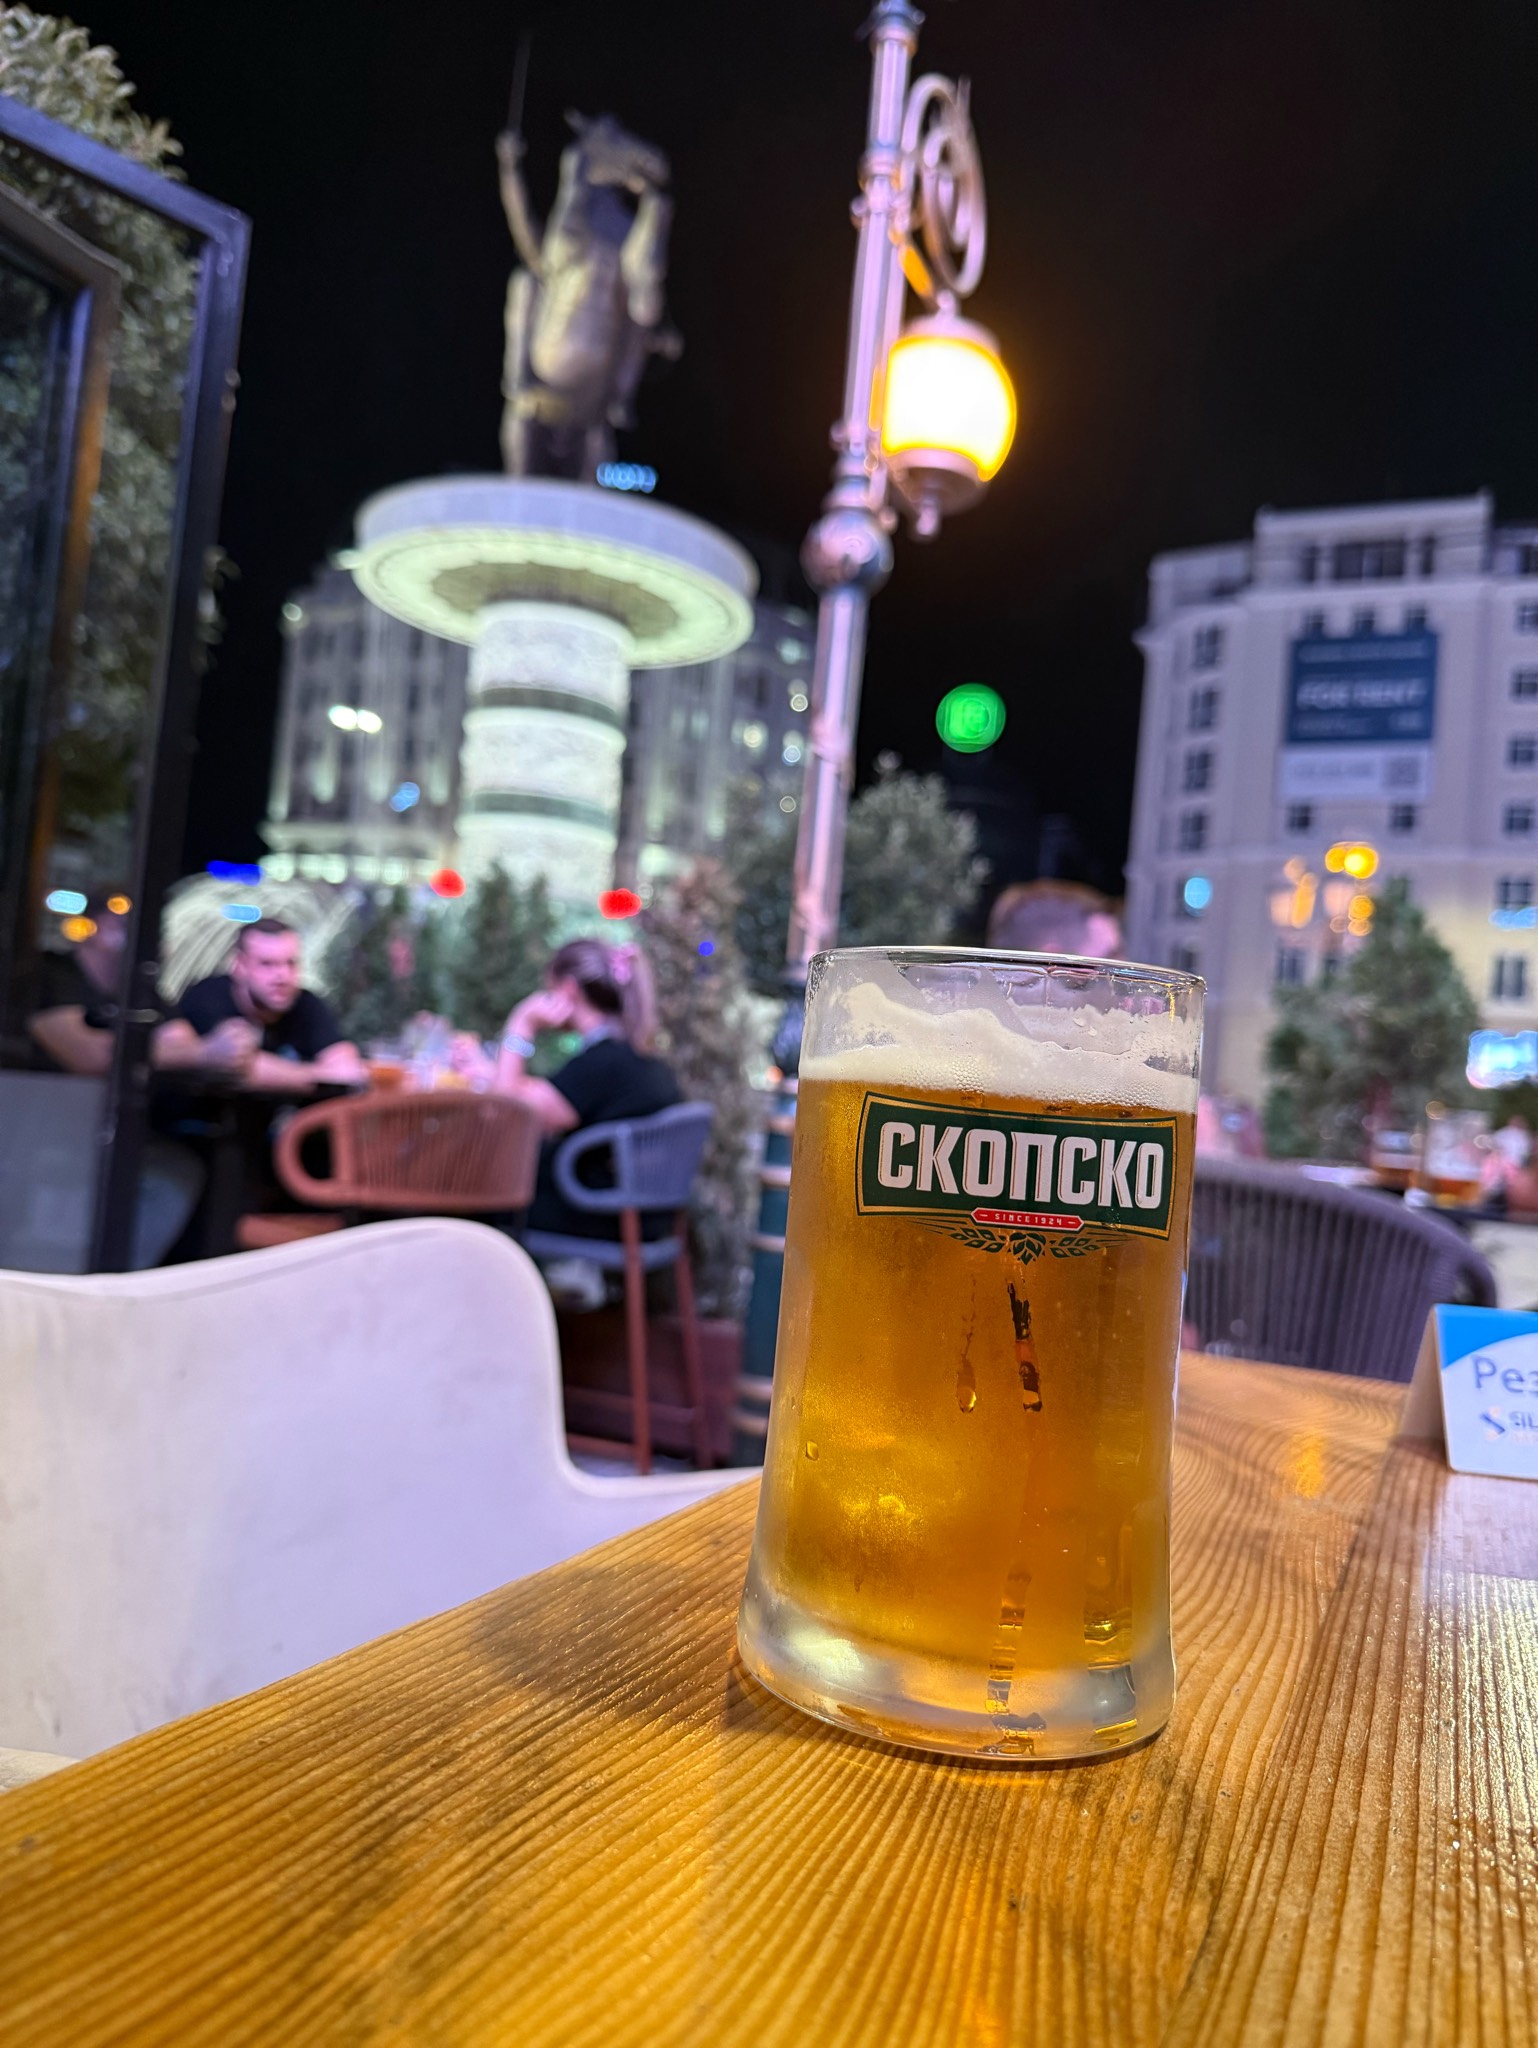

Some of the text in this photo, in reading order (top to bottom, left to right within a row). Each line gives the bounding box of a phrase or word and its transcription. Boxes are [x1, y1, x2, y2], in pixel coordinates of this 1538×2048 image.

[878, 1123, 1164, 1209] СКОПСКО
[994, 1213, 1062, 1226] SINCE 1924
